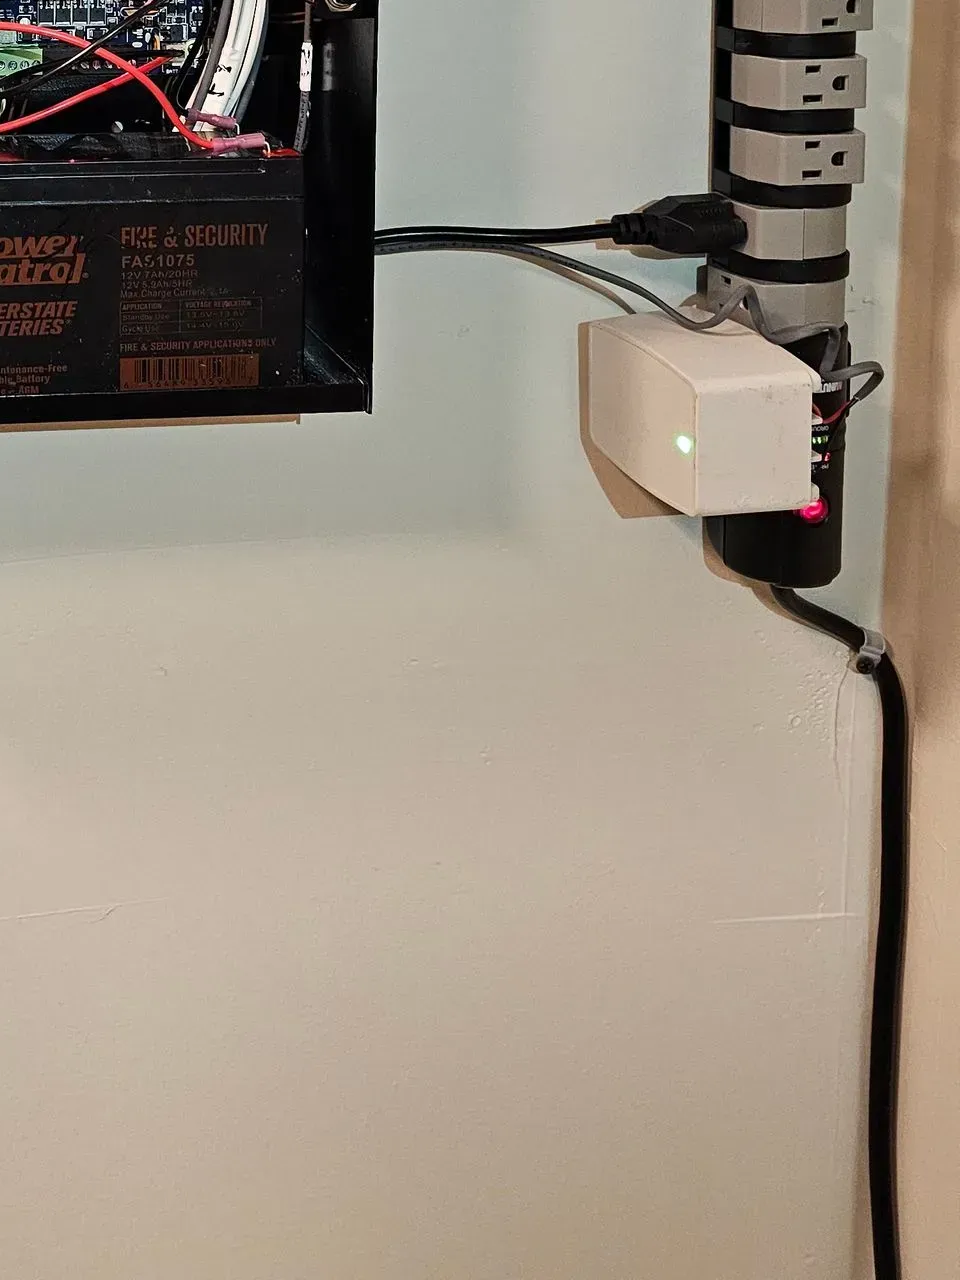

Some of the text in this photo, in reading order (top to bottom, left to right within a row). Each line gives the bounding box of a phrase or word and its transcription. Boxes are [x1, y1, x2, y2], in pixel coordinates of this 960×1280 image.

[121, 226, 157, 248] FIRE
[185, 223, 268, 247] SECURITY
[121, 254, 195, 269] FAS1075
[121, 271, 141, 280] 12V
[120, 343, 139, 352] FIRE
[150, 341, 190, 351] SECURITY
